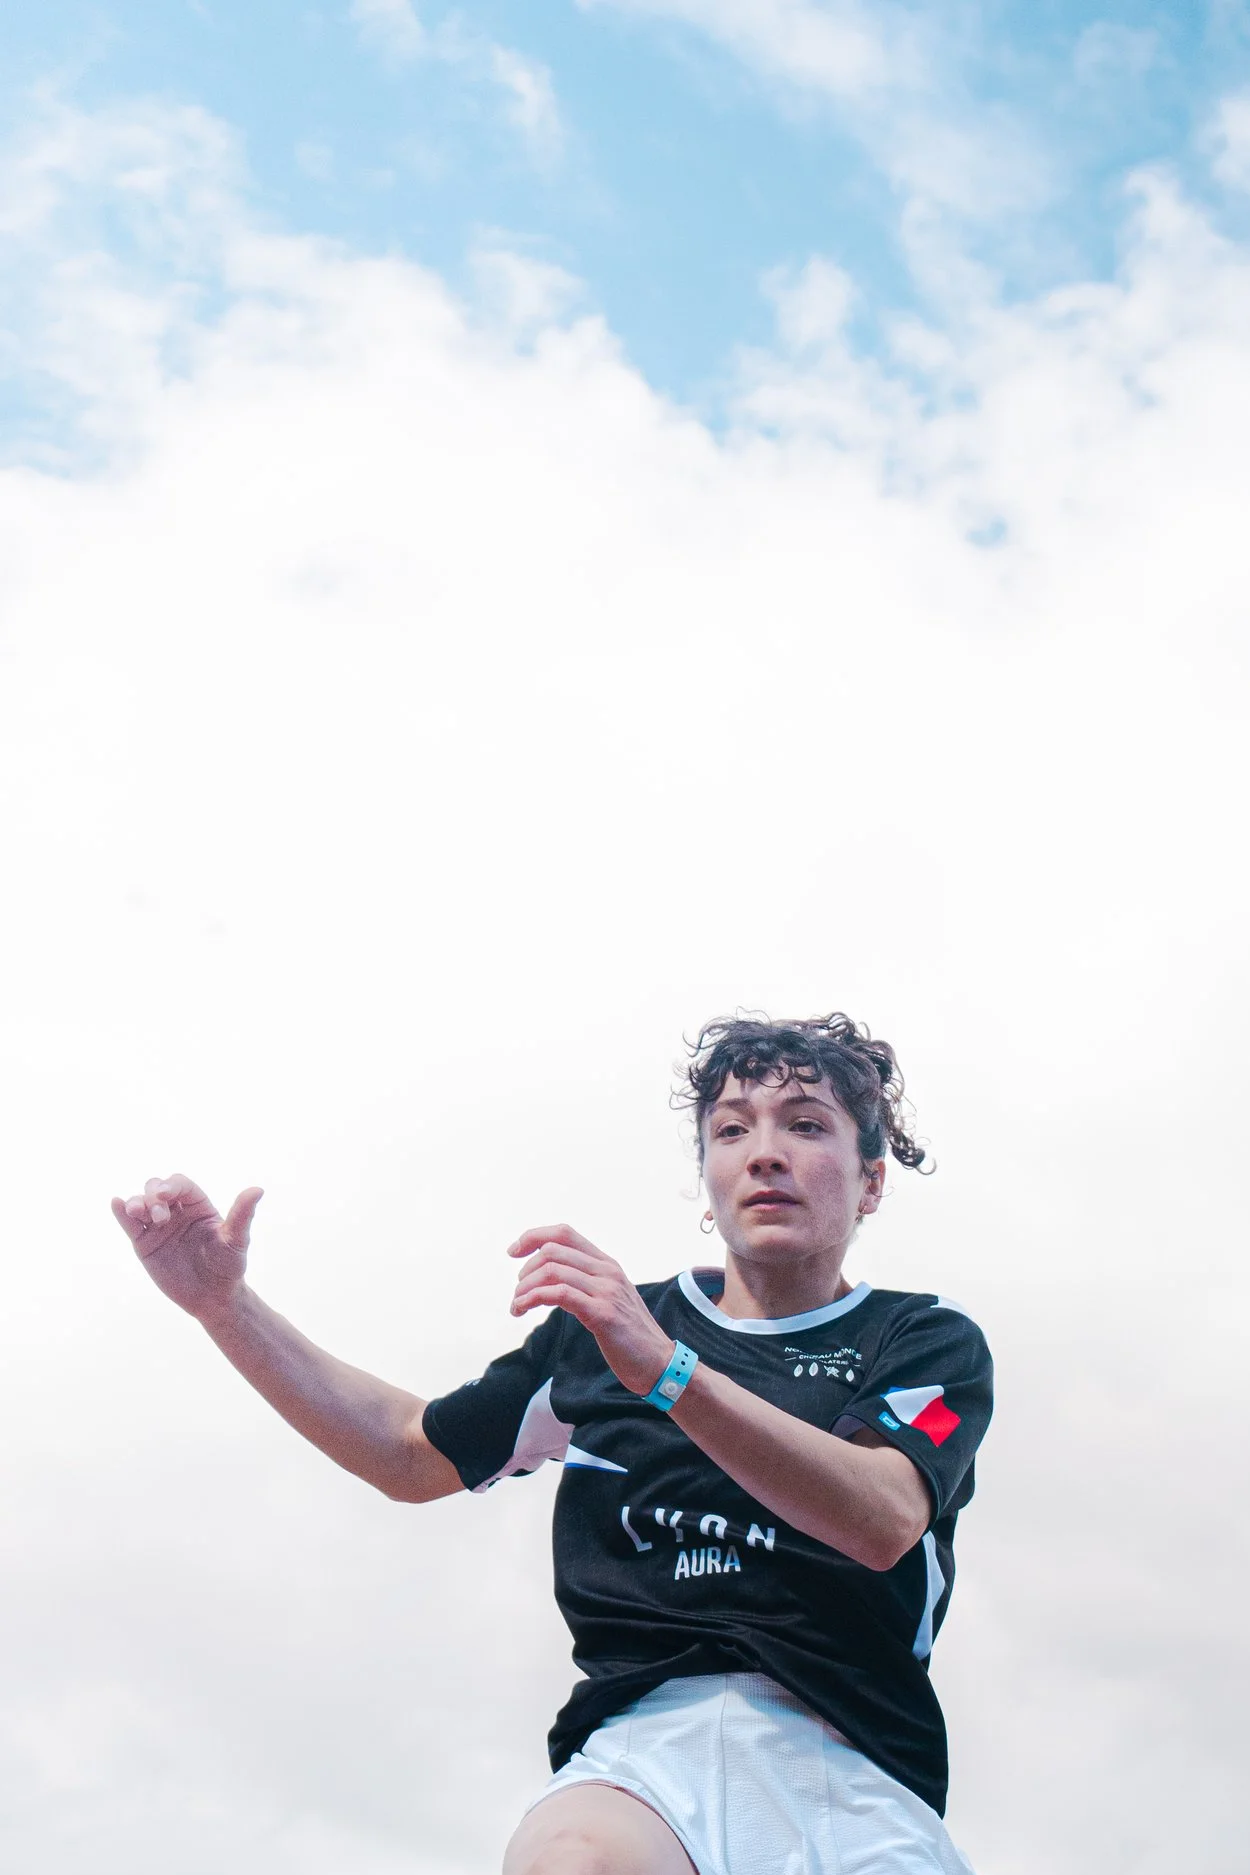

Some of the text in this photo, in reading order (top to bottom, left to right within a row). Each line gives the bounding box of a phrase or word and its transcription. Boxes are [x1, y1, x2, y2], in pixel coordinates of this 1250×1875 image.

[834, 1347, 863, 1361] MONDE
[621, 1505, 776, 1553] LYON
[674, 1545, 742, 1581] AURA
